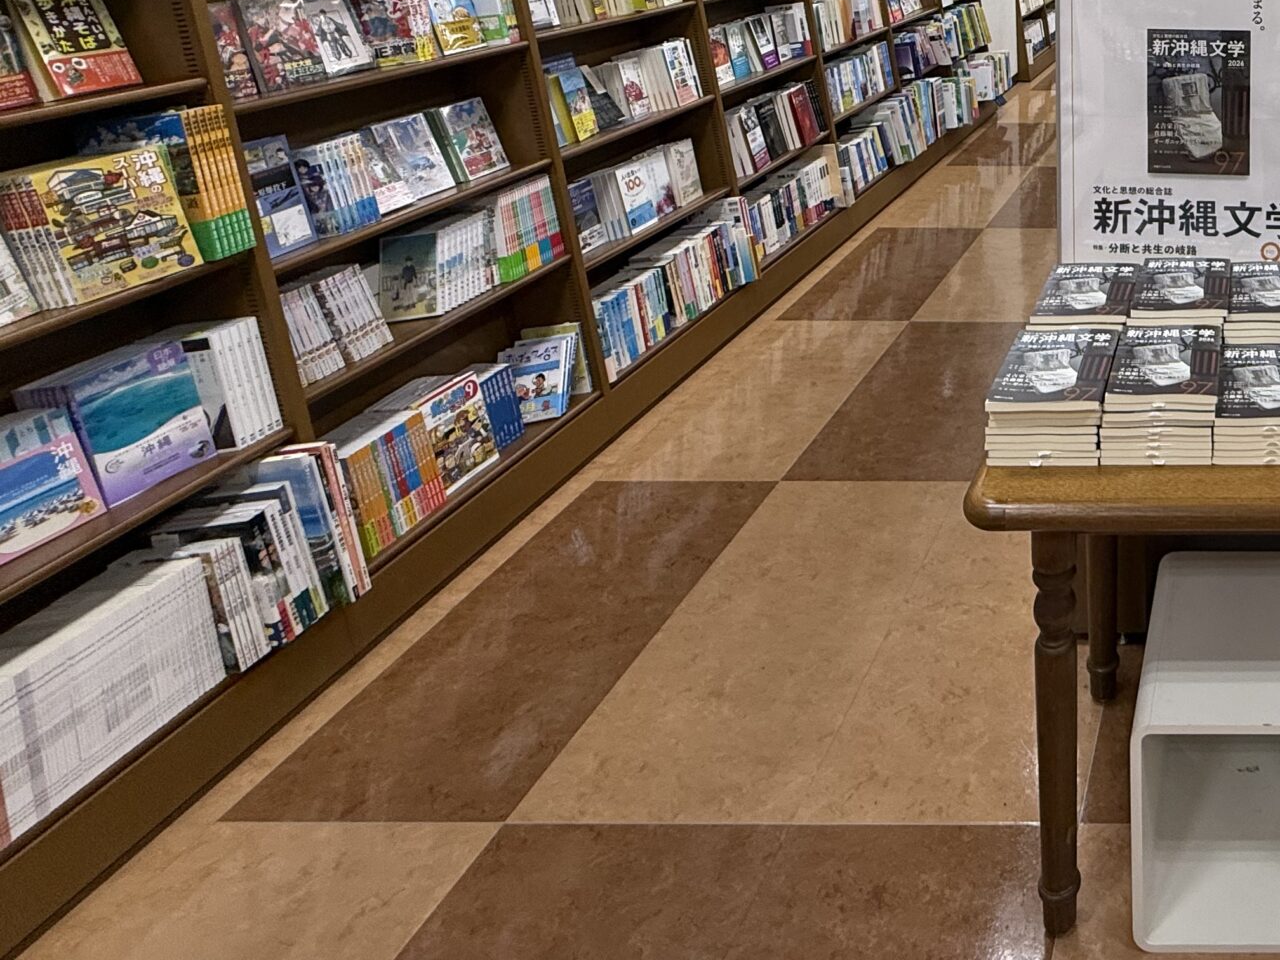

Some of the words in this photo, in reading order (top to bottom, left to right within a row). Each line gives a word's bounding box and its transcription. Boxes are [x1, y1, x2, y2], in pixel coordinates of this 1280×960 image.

[1152, 39, 1245, 58] 新沖縄文学
[1214, 151, 1245, 173] 97
[113, 157, 137, 198] スーパー
[1093, 186, 1173, 196] 文化と思想の総合誌
[1108, 243, 1197, 256] 分断と共生の岐路
[1021, 332, 1112, 344] 新沖縄文学
[1127, 327, 1215, 339] 新沖縄文学
